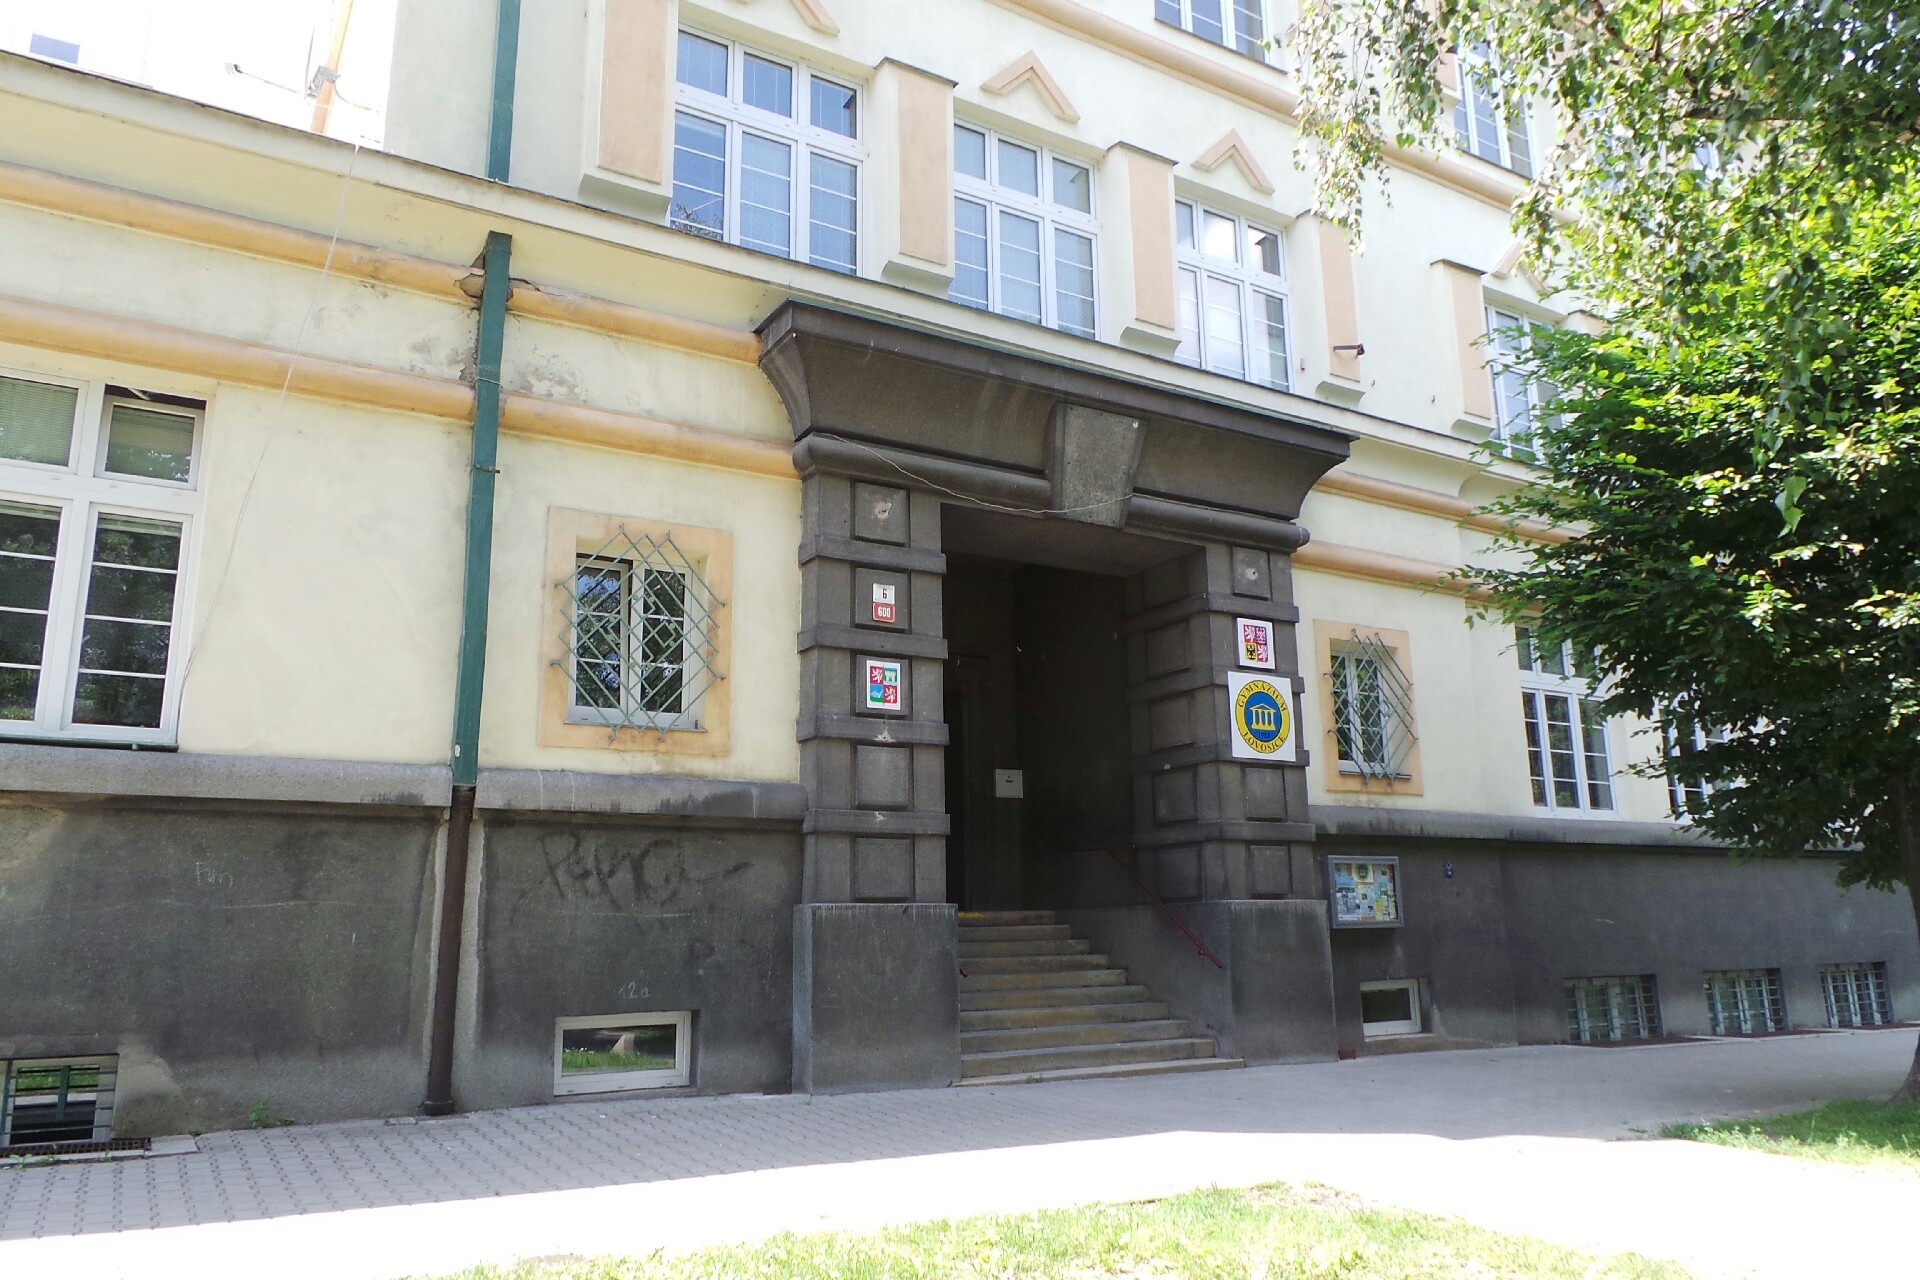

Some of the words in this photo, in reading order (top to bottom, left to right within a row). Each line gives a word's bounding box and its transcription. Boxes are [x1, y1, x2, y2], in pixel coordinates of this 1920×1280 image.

[882, 588, 888, 599] 6
[878, 607, 891, 618] 600
[1243, 732, 1286, 751] LOVOSICE
